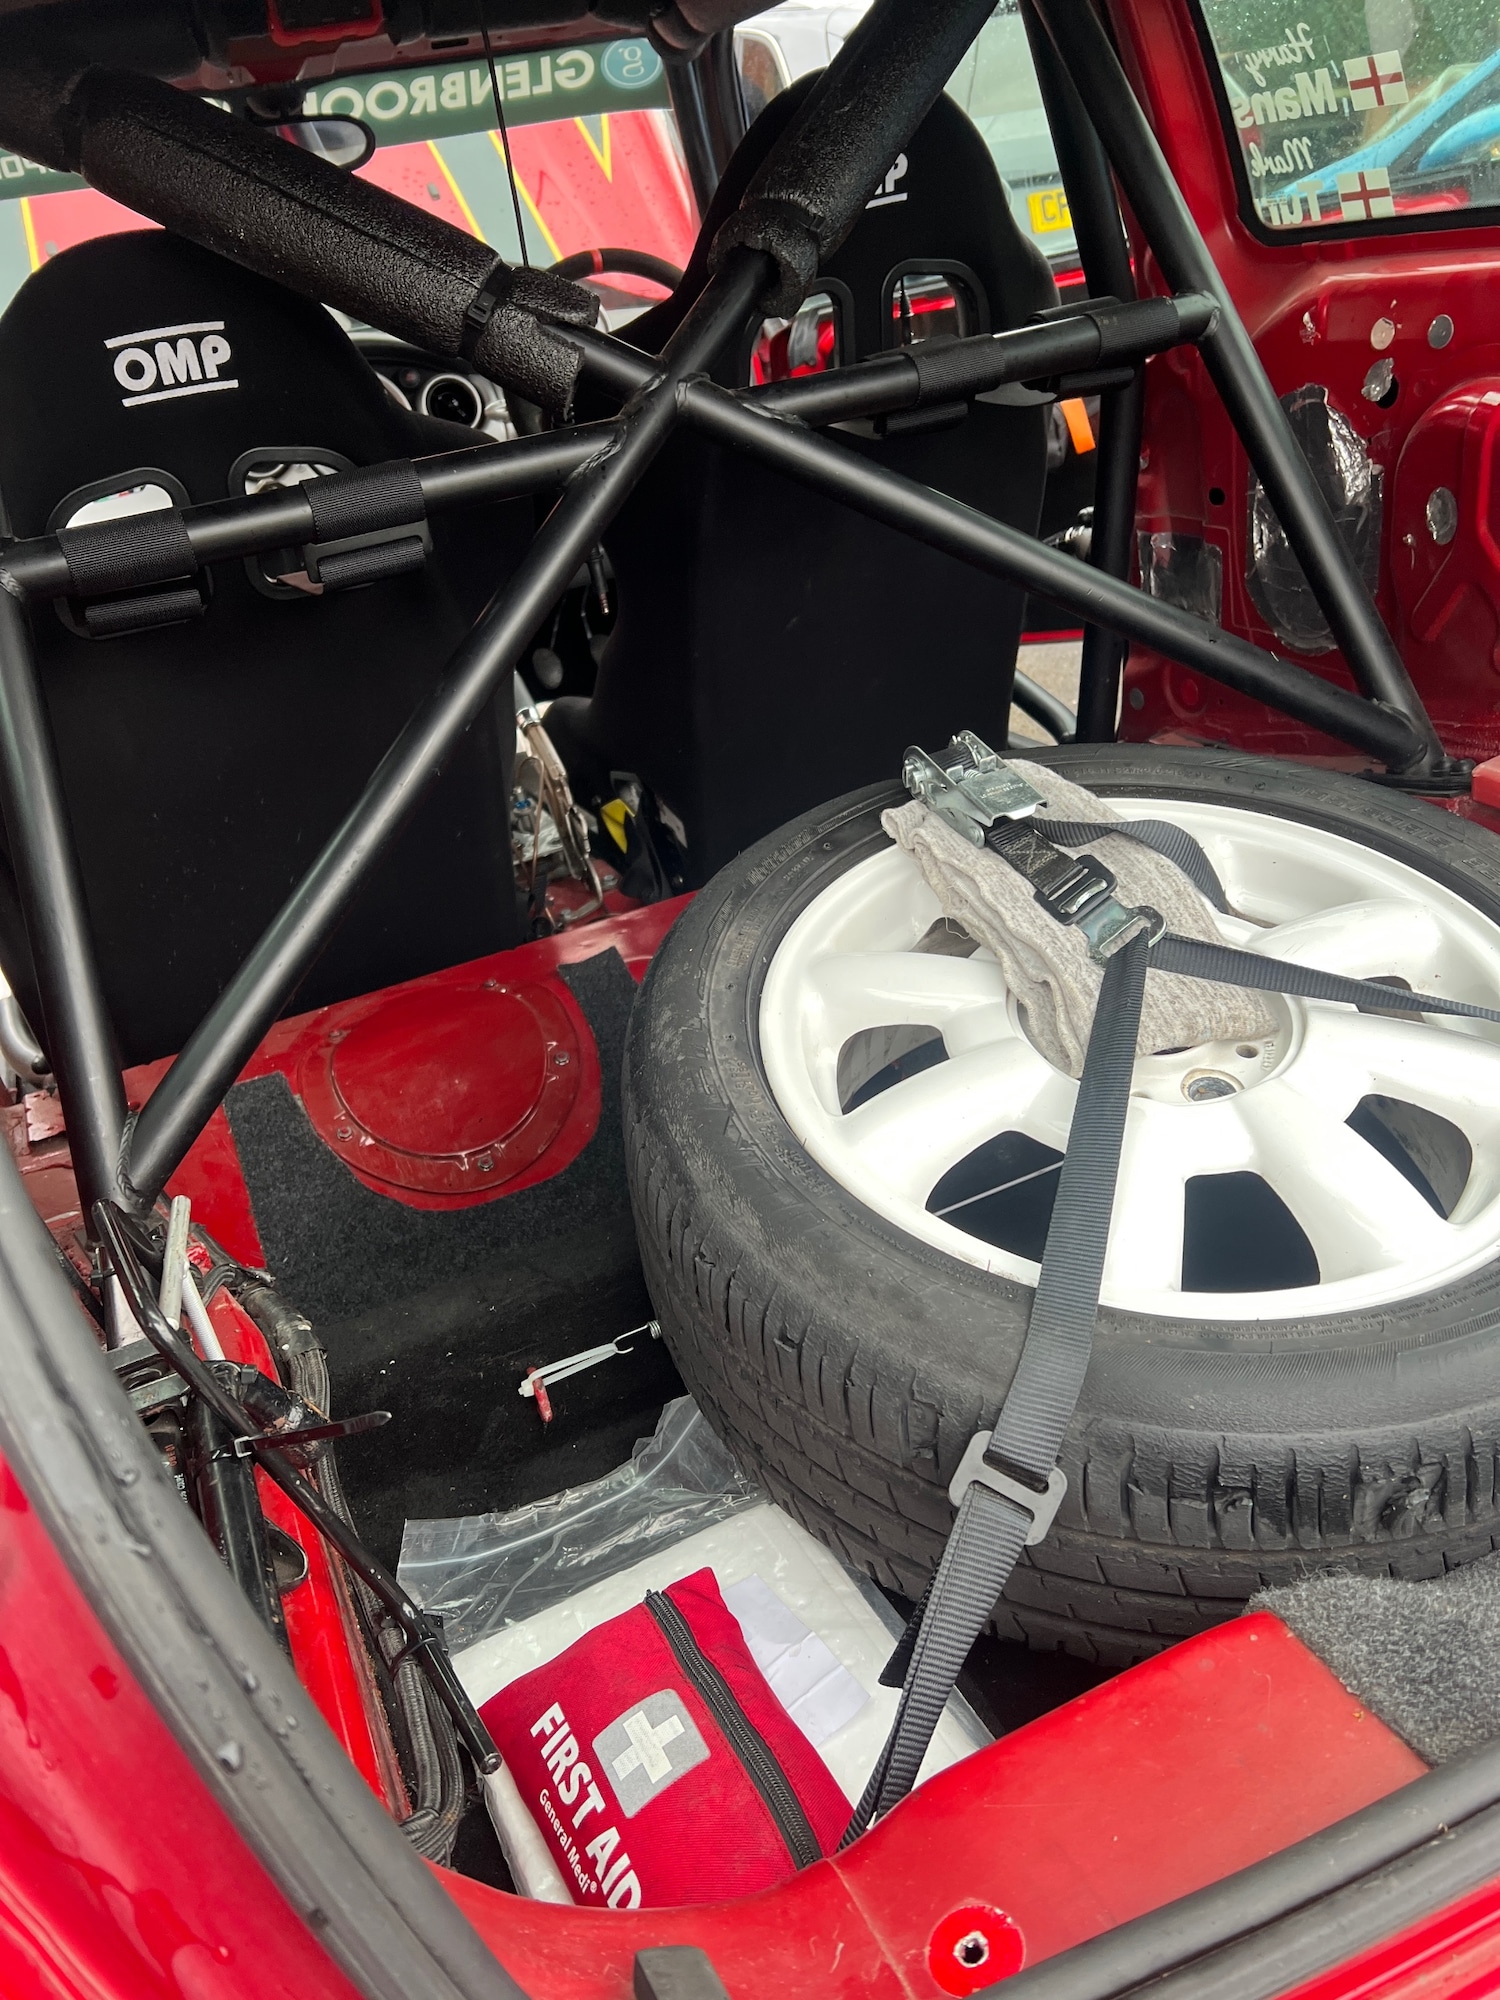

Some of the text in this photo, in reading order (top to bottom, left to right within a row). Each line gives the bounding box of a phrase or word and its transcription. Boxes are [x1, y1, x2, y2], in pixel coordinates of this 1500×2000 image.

[113, 334, 232, 392] OMP
[530, 1702, 642, 1909] FIRST AID
[539, 1788, 570, 1853] General
